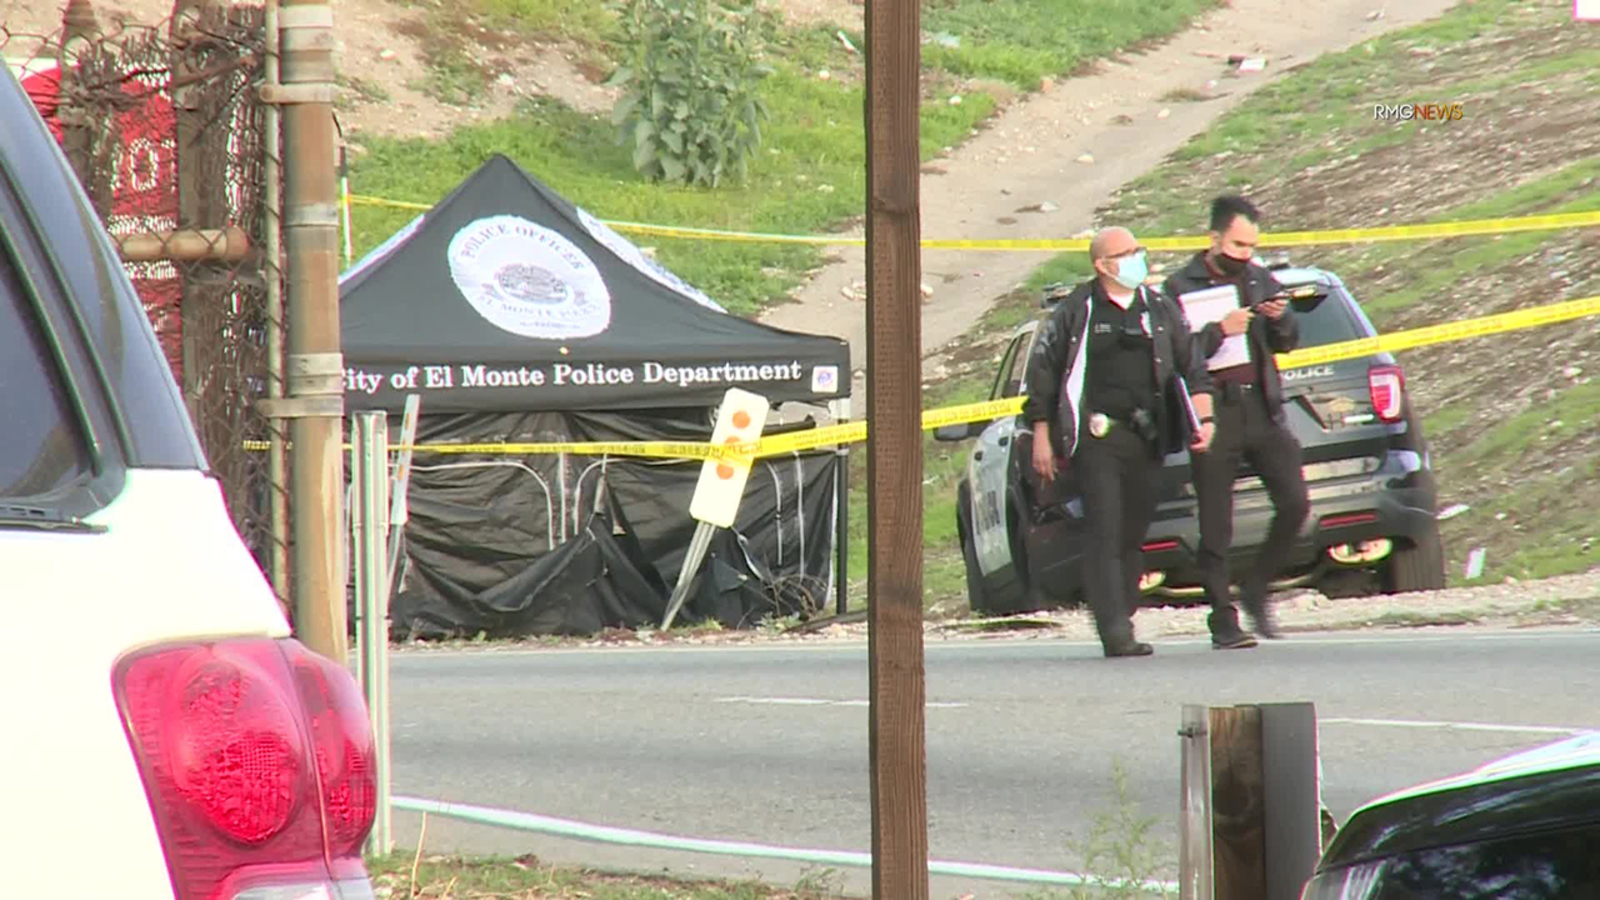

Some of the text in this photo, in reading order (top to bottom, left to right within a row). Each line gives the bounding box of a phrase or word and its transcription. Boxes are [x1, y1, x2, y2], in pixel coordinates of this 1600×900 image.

[461, 223, 509, 259] POLICE
[342, 366, 384, 394] ity
[390, 366, 419, 389] of
[425, 365, 454, 389] El
[461, 364, 546, 388] Monte
[553, 362, 635, 386] Police
[643, 359, 803, 385] Department
[1281, 365, 1335, 381] OLICE
